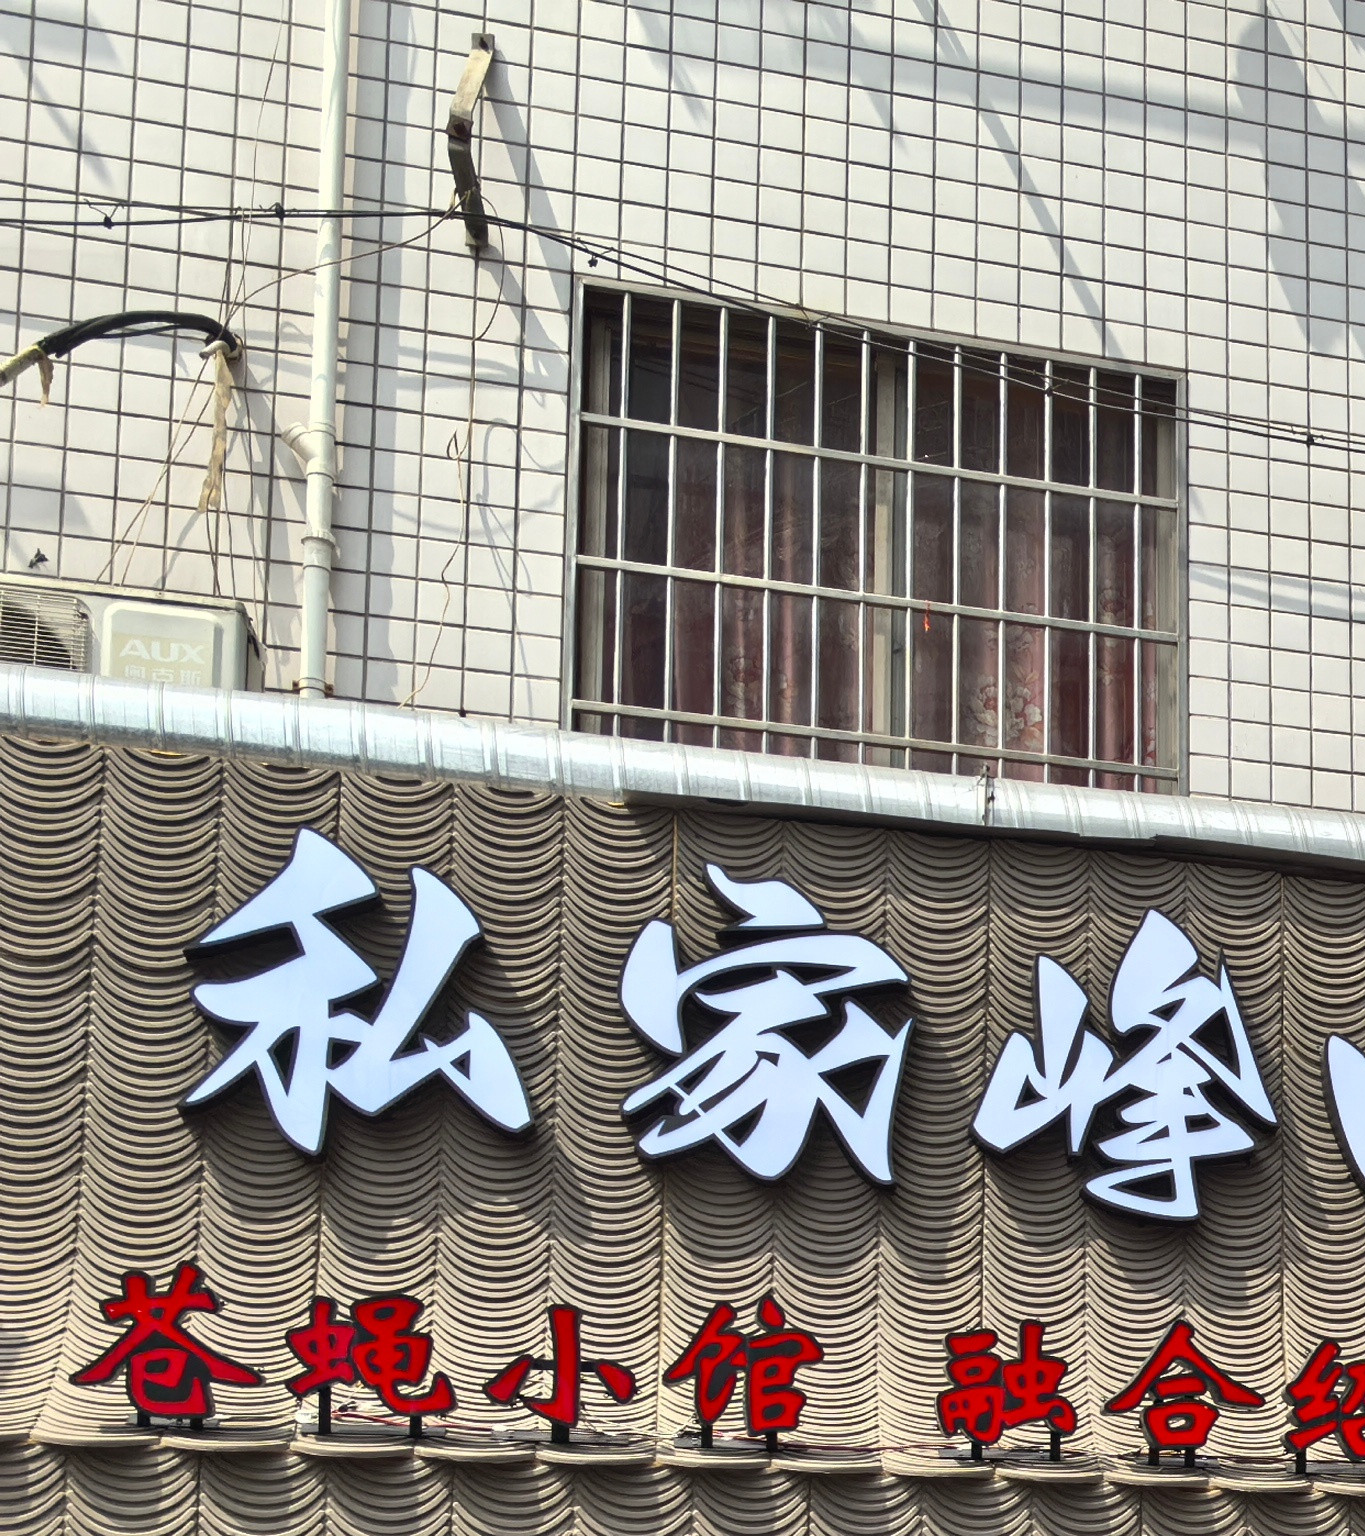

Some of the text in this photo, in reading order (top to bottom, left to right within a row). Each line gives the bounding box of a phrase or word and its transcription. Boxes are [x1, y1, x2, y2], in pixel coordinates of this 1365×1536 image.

[119, 639, 205, 664] AUX
[72, 1264, 824, 1432] 苍蝇小馆
